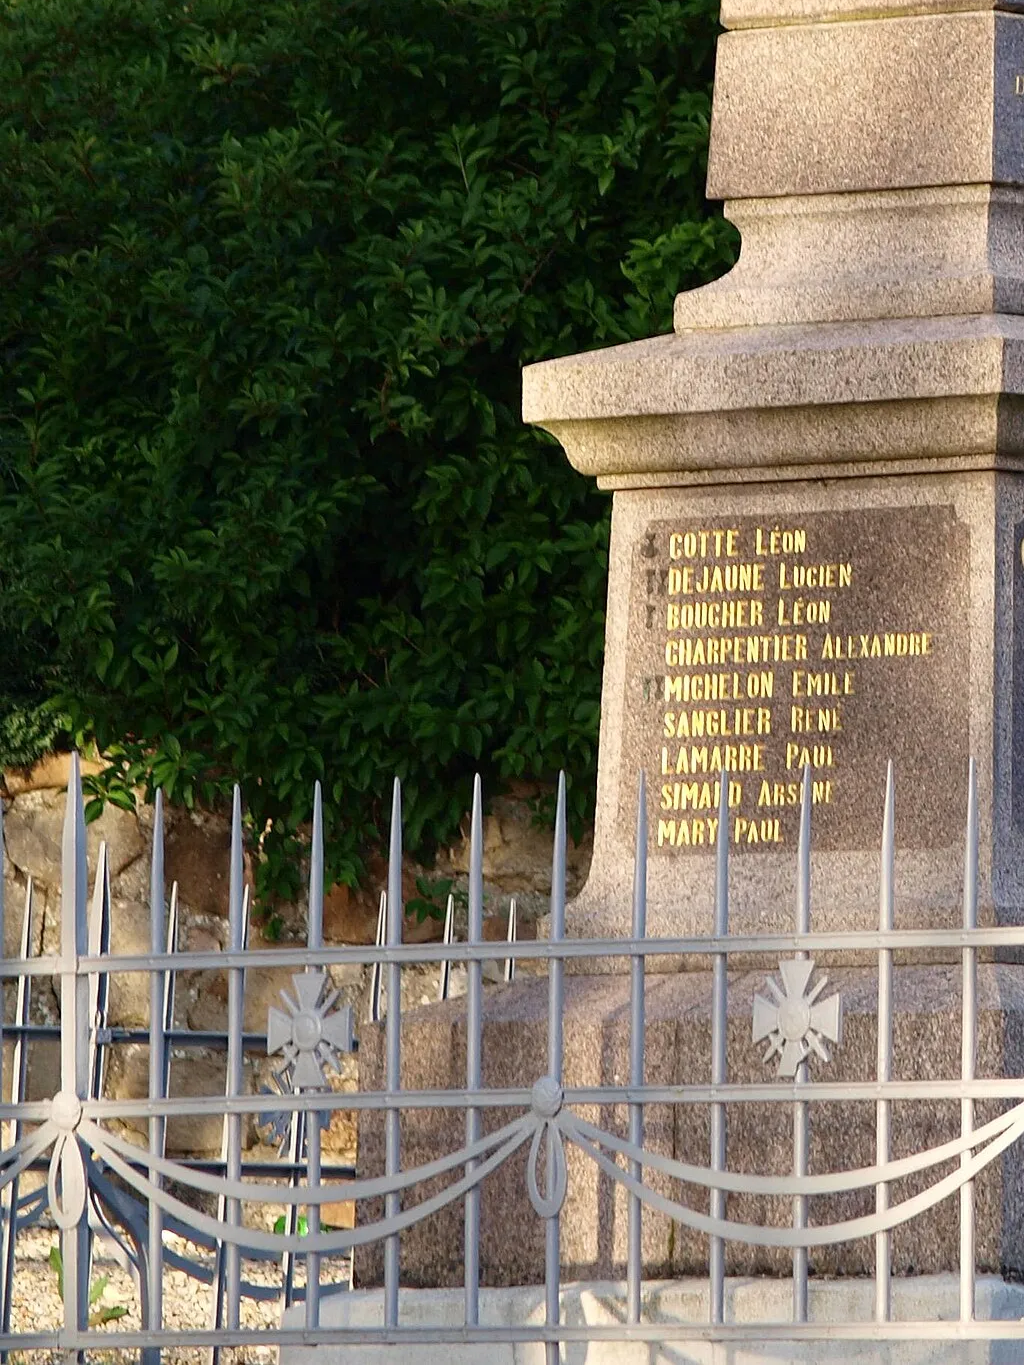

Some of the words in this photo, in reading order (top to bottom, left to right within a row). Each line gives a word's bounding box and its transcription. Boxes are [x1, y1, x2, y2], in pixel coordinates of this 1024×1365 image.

[669, 529, 739, 560] COTTE
[755, 525, 807, 557] LÉON
[668, 564, 765, 595] DEJAUNE
[779, 563, 852, 590] LUCIEN
[667, 600, 763, 631] BOUCHER
[778, 597, 831, 627] LÉON
[665, 634, 807, 666] CHARPENTIER
[821, 633, 932, 660] ALEXANDRE
[664, 671, 774, 702] MICHELON
[664, 707, 771, 738] SANGLIER
[662, 743, 766, 775] LAMARRE
[786, 742, 836, 770] PAUL
[758, 779, 833, 806] ARSNE
[657, 818, 719, 847] MARY
[735, 817, 784, 844] PAUL
